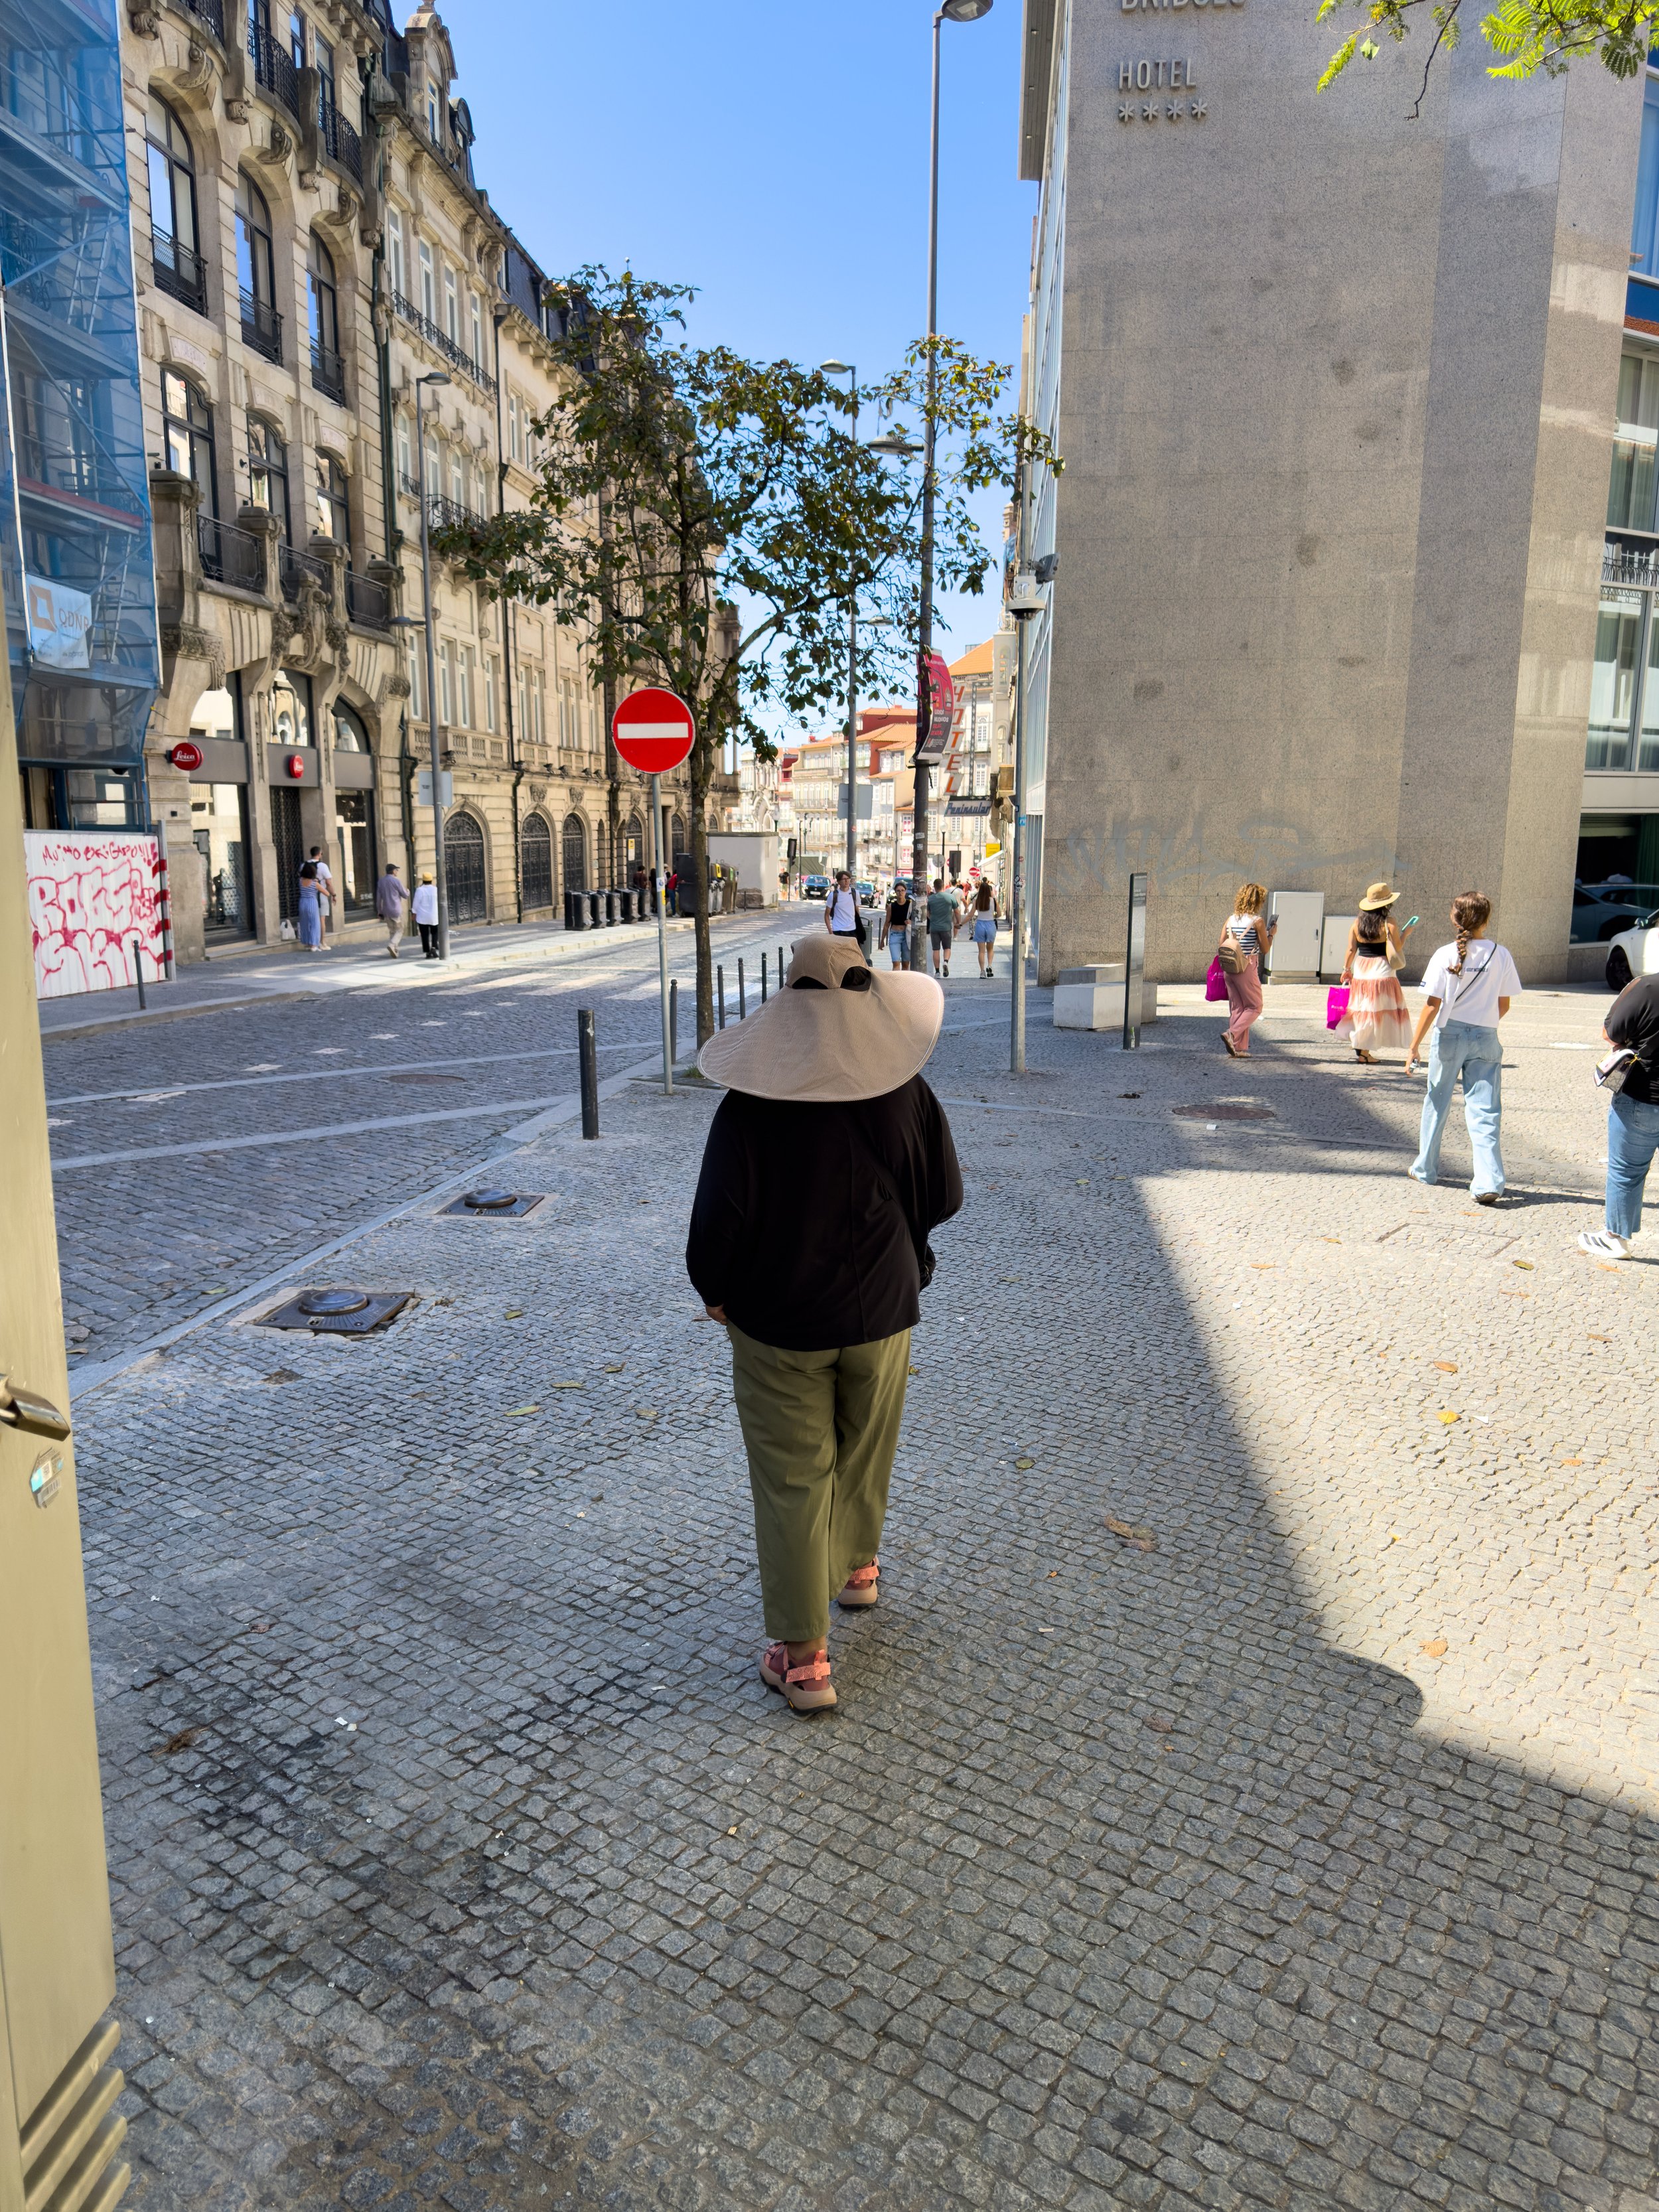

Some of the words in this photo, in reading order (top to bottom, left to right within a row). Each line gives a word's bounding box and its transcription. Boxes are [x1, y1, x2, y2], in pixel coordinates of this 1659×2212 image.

[1118, 58, 1196, 90] HOTEL
[945, 686, 965, 793] HOTEL
[174, 750, 196, 762] Leica
[945, 800, 991, 816] Peninsular
